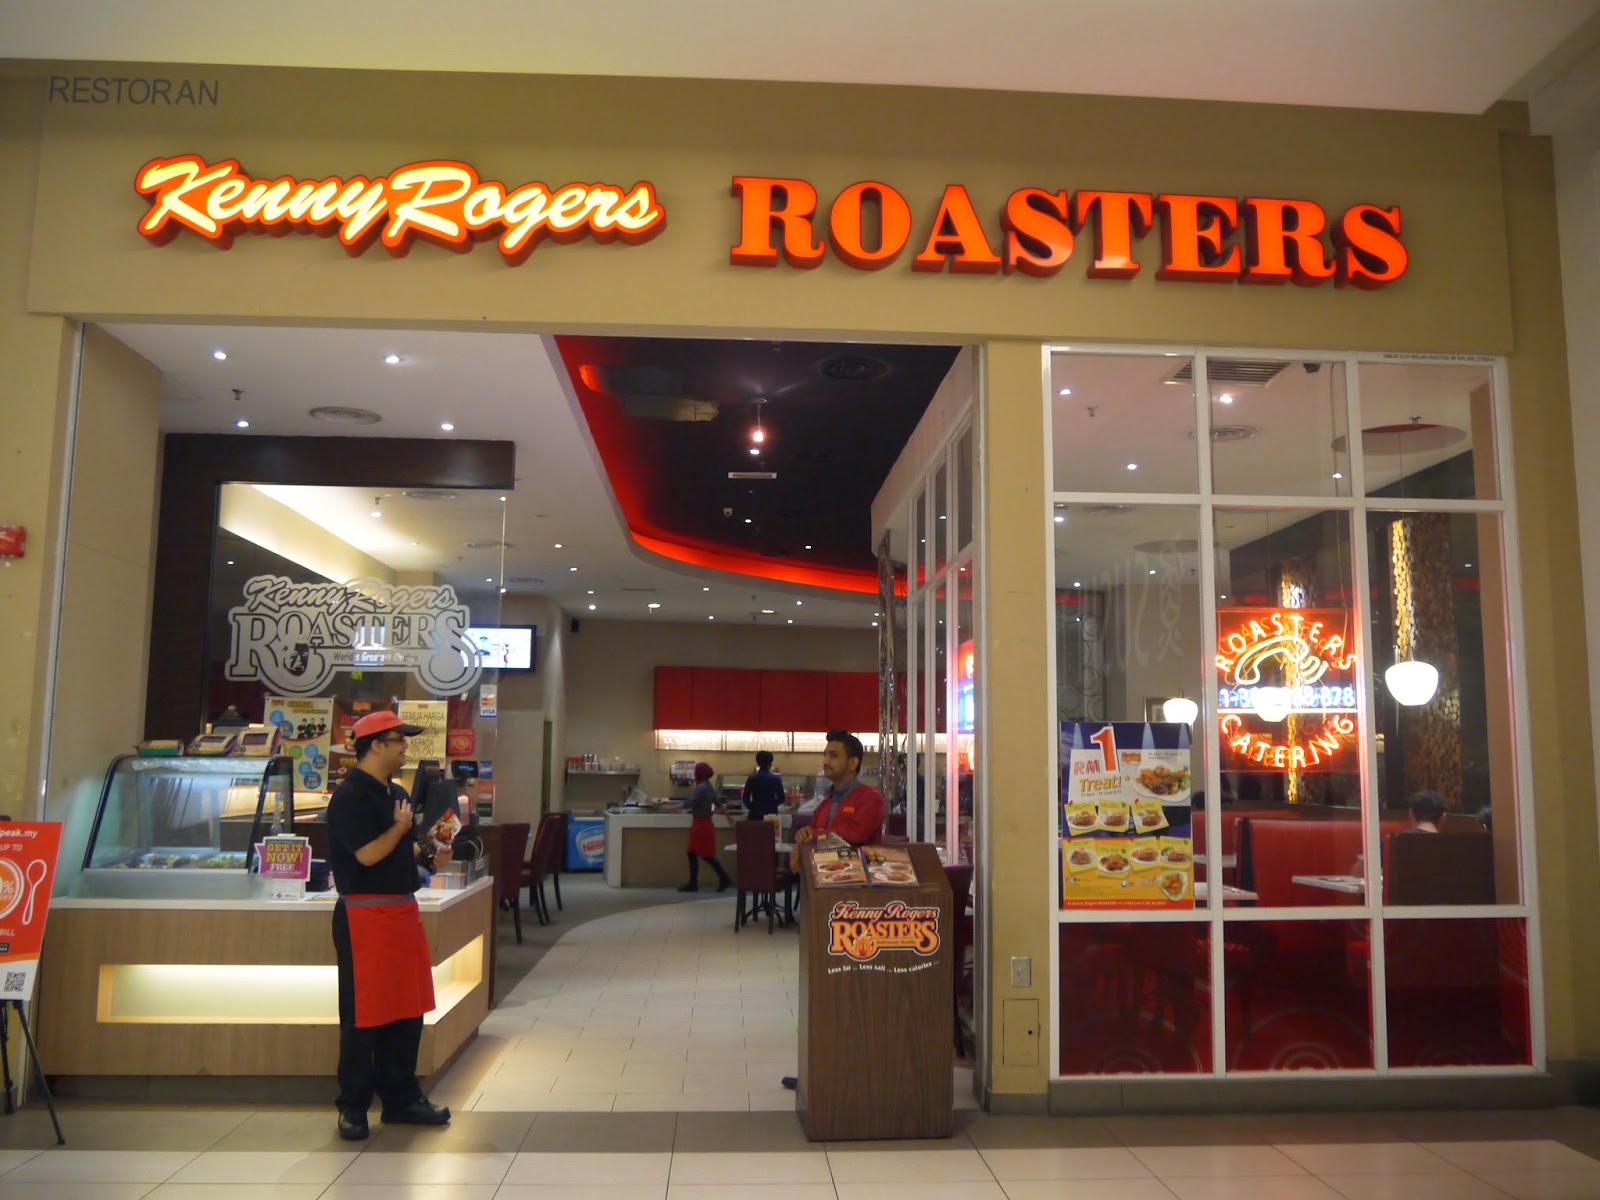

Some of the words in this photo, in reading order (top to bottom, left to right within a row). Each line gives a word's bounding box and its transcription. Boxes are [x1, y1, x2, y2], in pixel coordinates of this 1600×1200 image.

[49, 75, 219, 106] RESTORAN
[138, 158, 389, 245] Kenny
[387, 164, 660, 251] Rogers
[731, 175, 1409, 285] ROASTERS
[245, 578, 348, 614] Kenny
[346, 580, 456, 613] Rogers
[230, 609, 479, 691] ROASTERS
[1215, 612, 1358, 673] ROASTERS
[1221, 714, 1354, 768] CATERING
[1080, 775, 1122, 793] Treat!
[13, 844, 23, 852] TO
[265, 852, 304, 864] NOW!
[267, 843, 289, 853] GET
[291, 844, 304, 853] IT
[270, 863, 296, 872] FREE
[832, 903, 884, 922] Kenny
[884, 903, 938, 922] Rogers
[831, 921, 939, 959] ROASTERS
[874, 964, 886, 972] salt
[908, 961, 933, 972] calories
